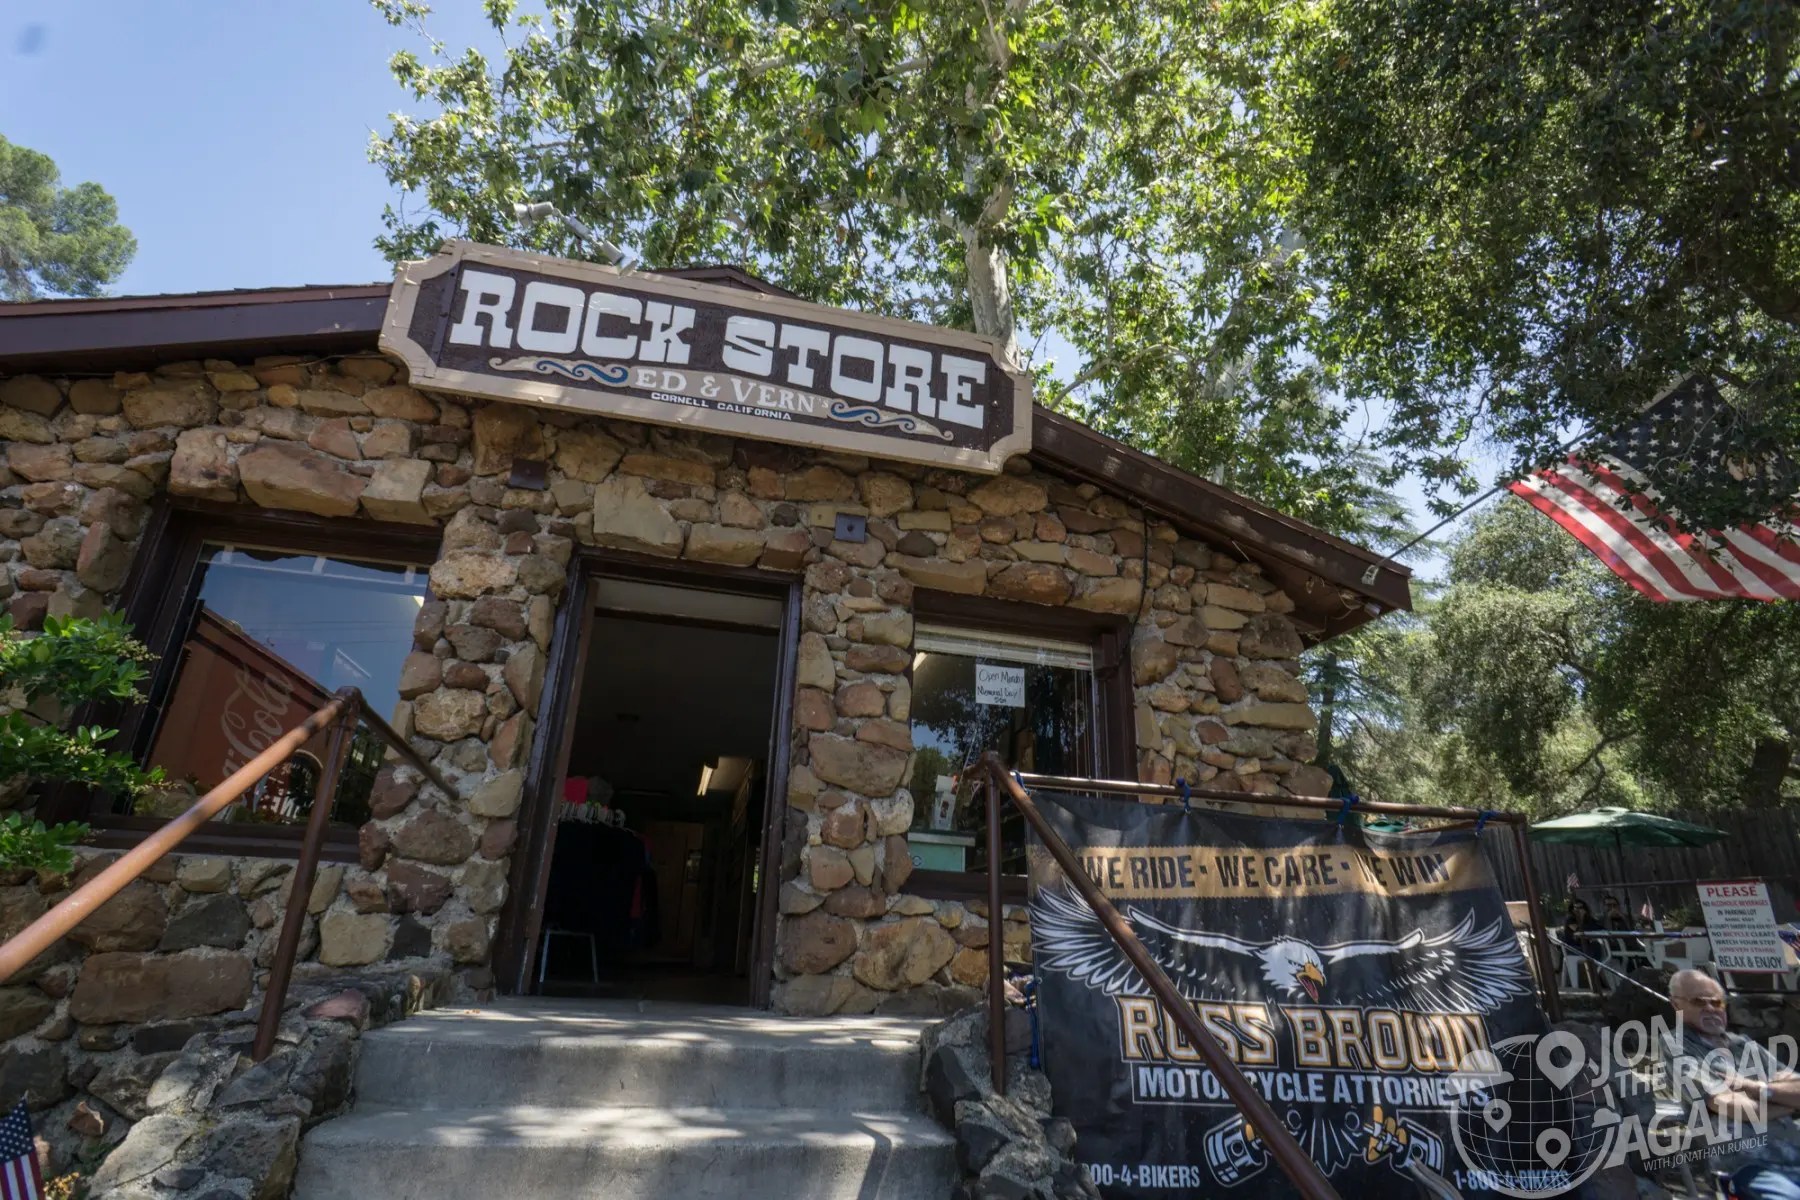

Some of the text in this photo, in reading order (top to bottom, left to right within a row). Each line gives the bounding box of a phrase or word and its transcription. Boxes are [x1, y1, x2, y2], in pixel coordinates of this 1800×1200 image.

[449, 269, 986, 430] ROCK STORE
[635, 368, 687, 392] ED
[700, 375, 721, 398] &
[650, 391, 793, 421] CORNELL CALIFORNIA
[1078, 855, 1125, 889] WE
[1129, 854, 1196, 890] RIDE
[1214, 855, 1261, 888] WE
[1263, 853, 1339, 888] CARE
[1388, 853, 1451, 886] WIN
[1706, 886, 1758, 897] PLEASE
[1718, 956, 1783, 969] RELAX & ENJOY
[1284, 1007, 1493, 1073] BROWN
[1138, 1067, 1491, 1107] MOTOYCLE ATTORNEYS
[1089, 1163, 1200, 1188] 00-4-BIKERS
